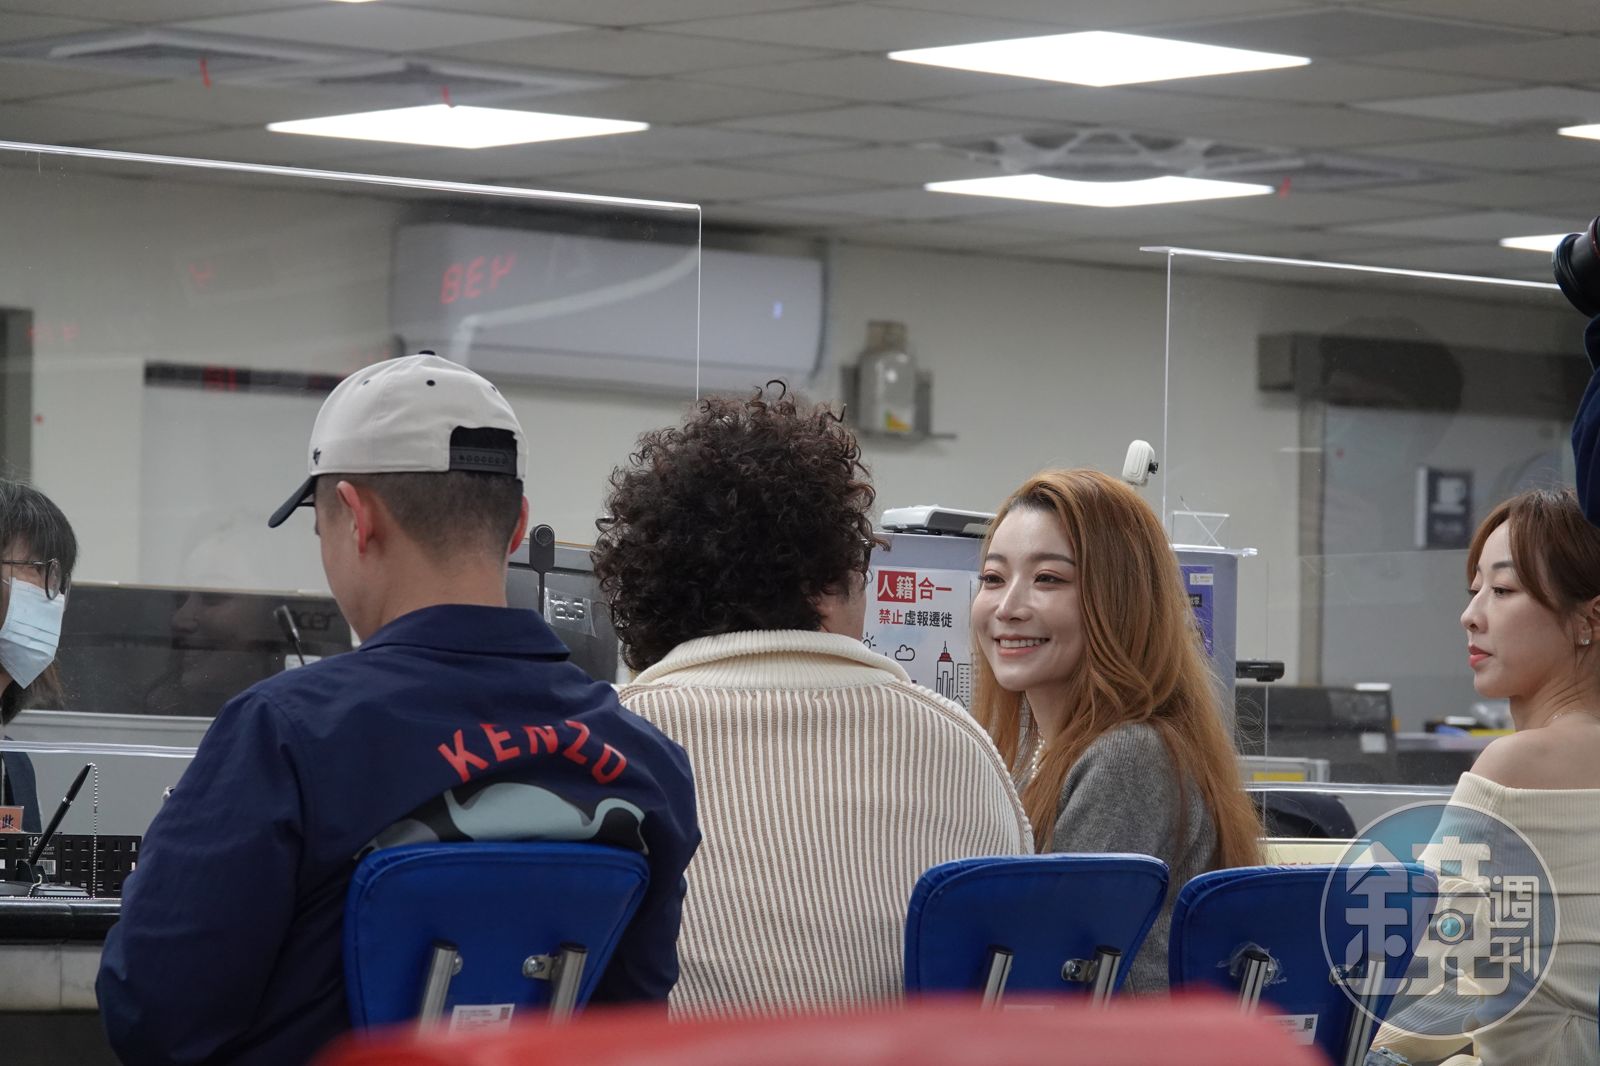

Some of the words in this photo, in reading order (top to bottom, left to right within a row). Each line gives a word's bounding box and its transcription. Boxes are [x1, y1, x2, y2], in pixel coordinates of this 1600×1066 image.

[878, 574, 953, 600] 人籍合一
[878, 608, 953, 628] 禁止虛報遷徙
[437, 719, 628, 784] KENZO
